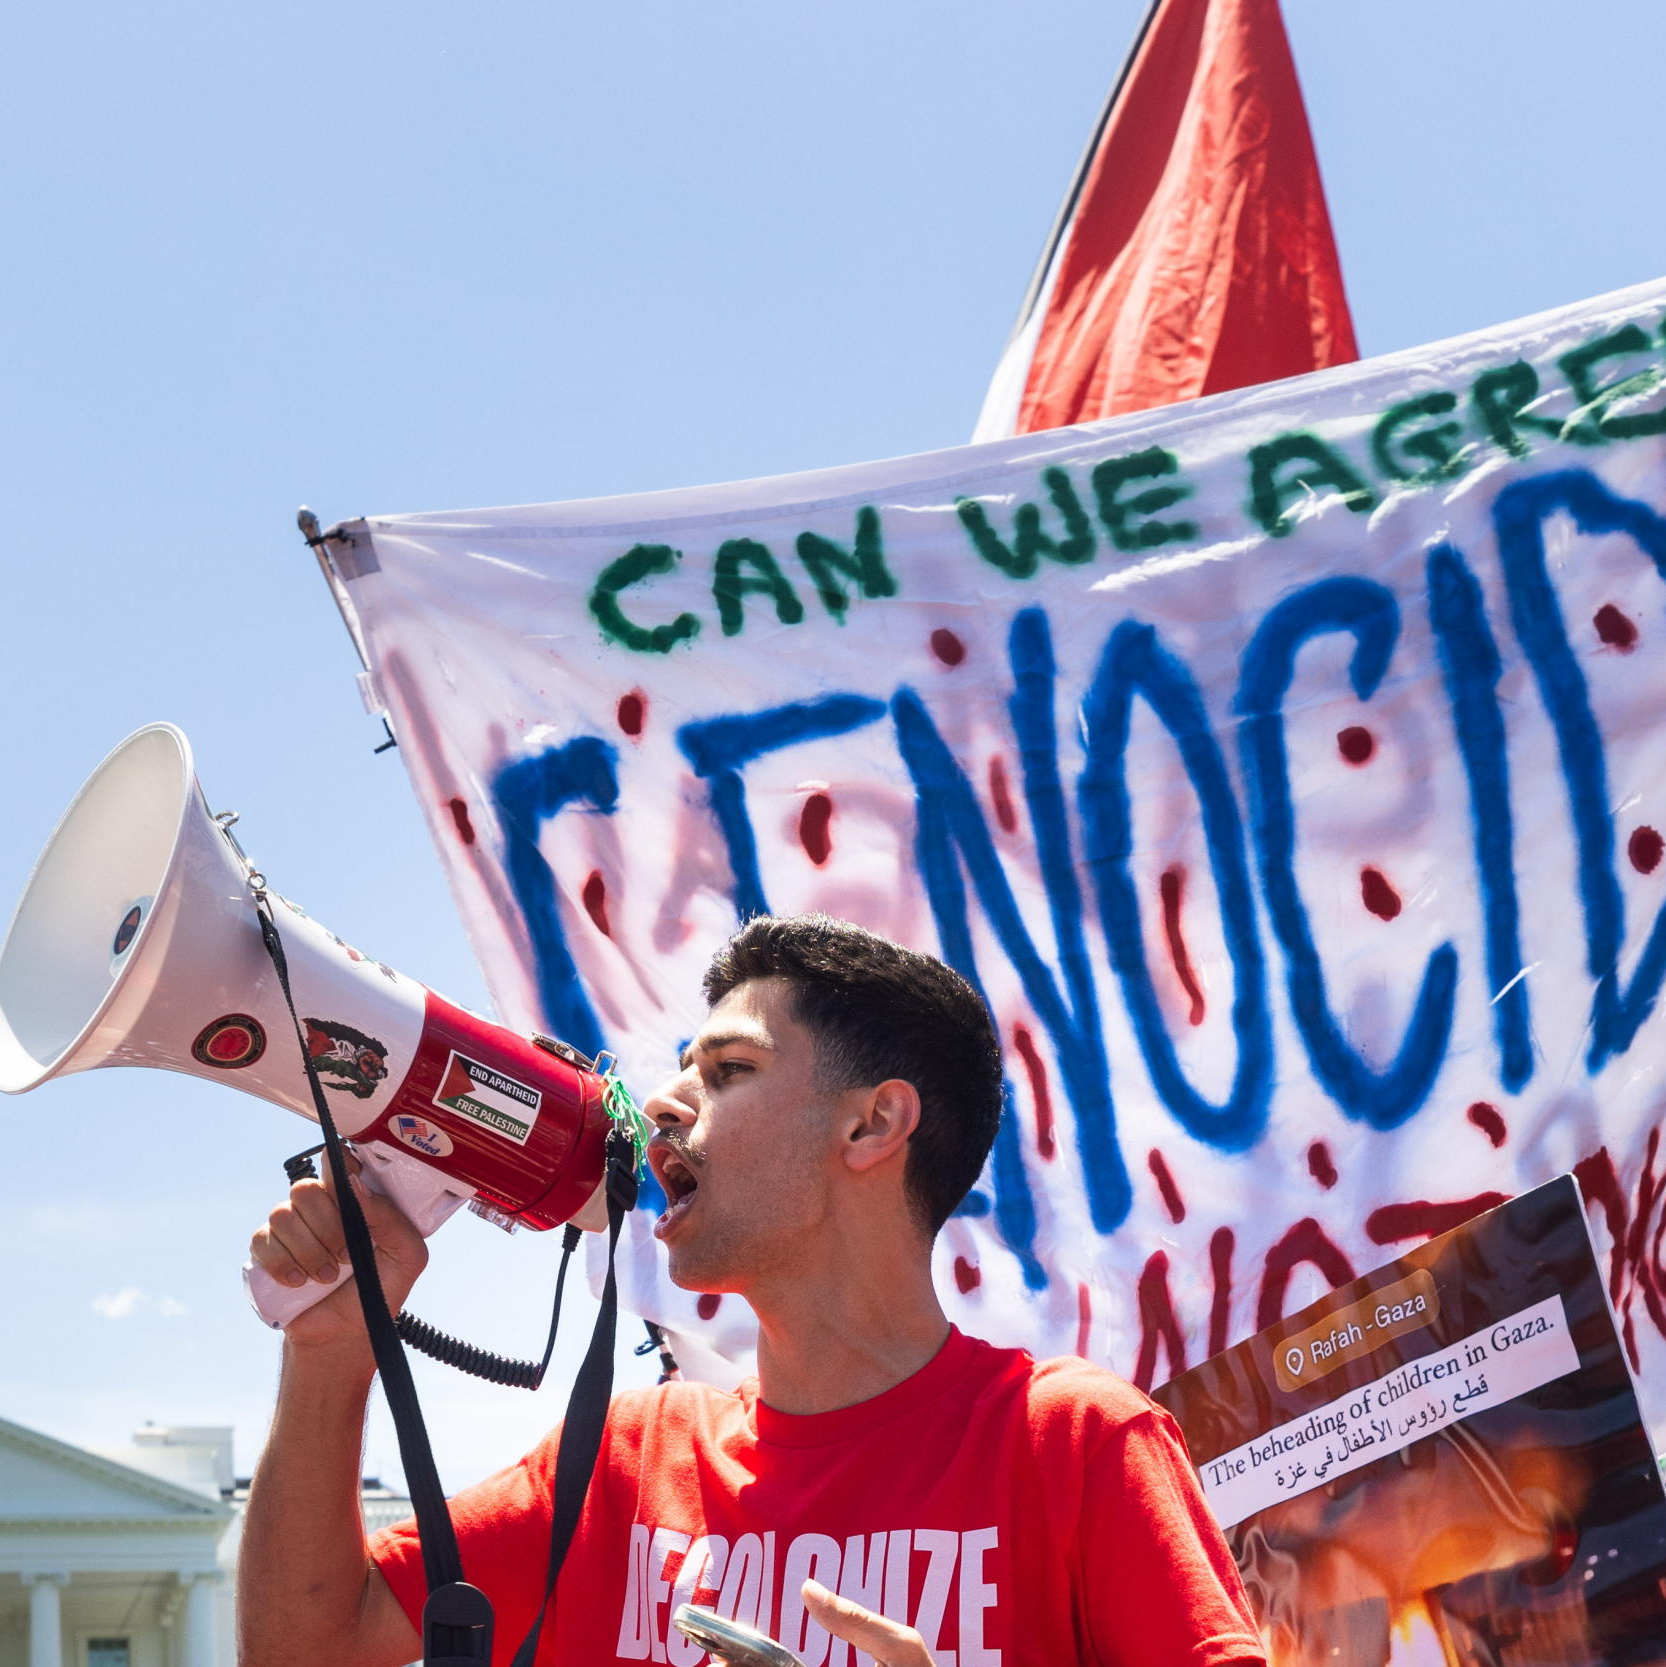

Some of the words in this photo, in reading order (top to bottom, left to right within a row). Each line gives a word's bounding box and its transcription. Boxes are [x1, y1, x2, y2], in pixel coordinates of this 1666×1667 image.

[588, 508, 894, 653] CAN
[960, 444, 1196, 579] WE
[470, 1066, 488, 1082] END
[488, 1076, 537, 1106] APARTHEID
[455, 1099, 479, 1117] FREE
[480, 1108, 527, 1138] PALESTINE
[410, 1135, 441, 1155] Voted
[1310, 1326, 1363, 1364] Rafah
[1374, 1294, 1427, 1330] Gaza
[1208, 1459, 1247, 1488] The
[1249, 1411, 1347, 1468] beheading
[1349, 1390, 1372, 1421] of
[1377, 1354, 1462, 1408] children
[1467, 1344, 1488, 1368] in
[1490, 1314, 1555, 1353] Gaza.
[1452, 1374, 1490, 1413] قطع
[1337, 1417, 1393, 1462] الأطفال
[1275, 1462, 1308, 1490] غزة
[1314, 1451, 1334, 1479] في
